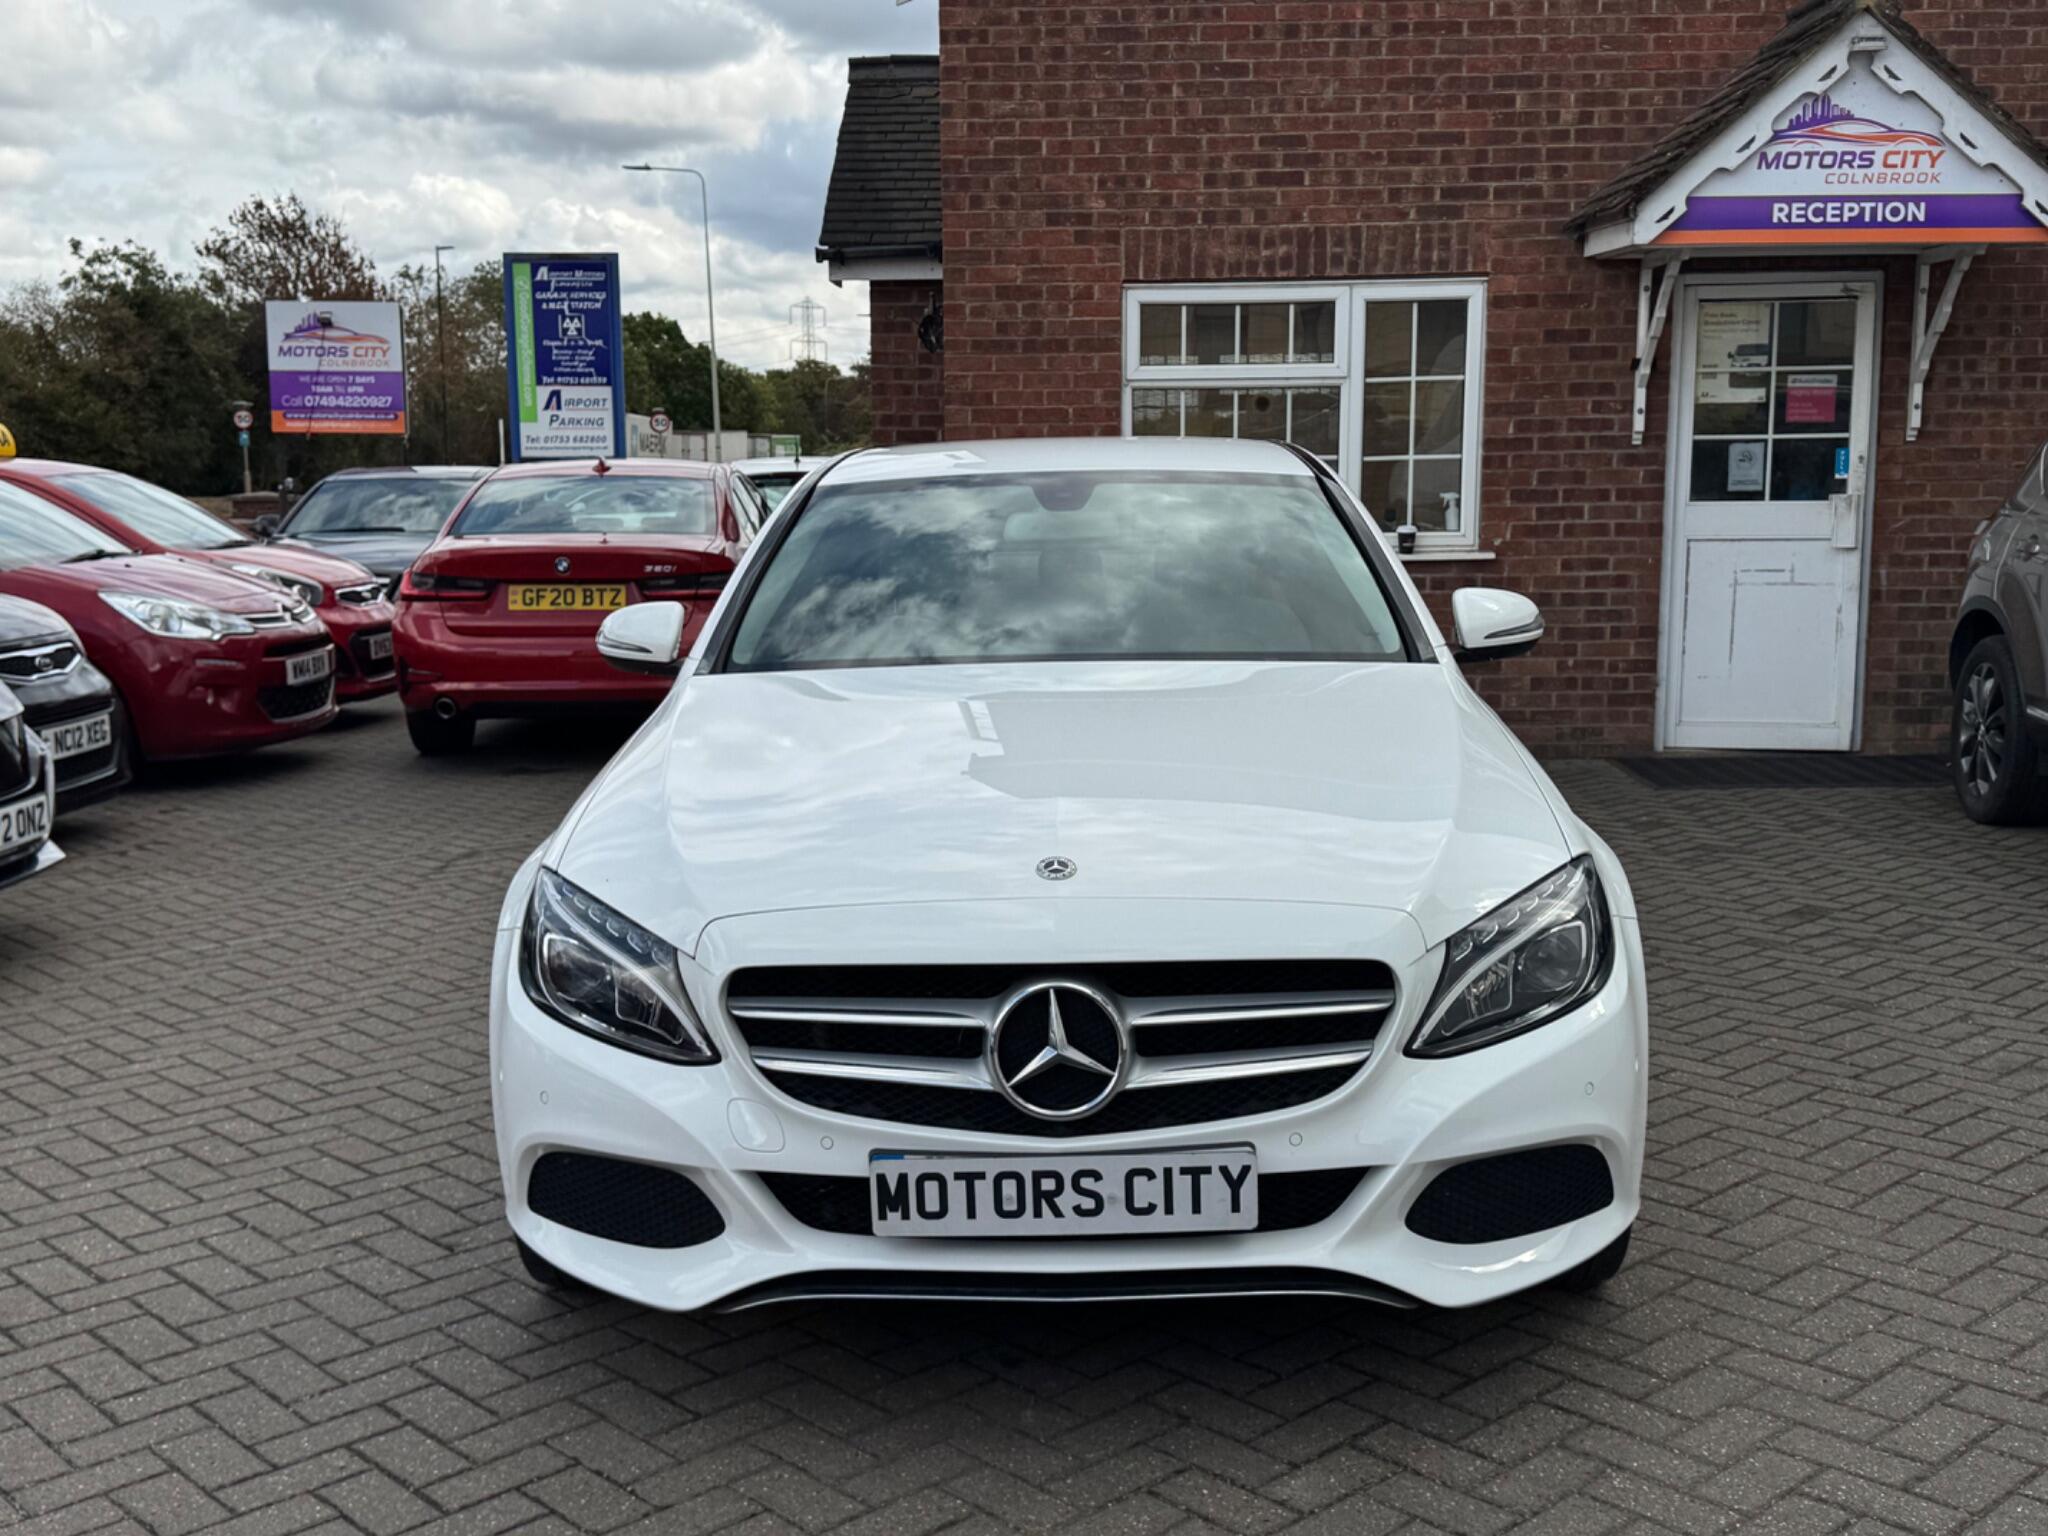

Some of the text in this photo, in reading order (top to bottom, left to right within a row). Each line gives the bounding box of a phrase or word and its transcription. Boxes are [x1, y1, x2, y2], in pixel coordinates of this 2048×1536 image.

[1757, 149, 1945, 170] MOTORS CITY
[1824, 172, 1942, 185] COLNBROOK
[1772, 201, 1926, 223] RECEPTION
[277, 346, 390, 358] MOTORS CITY
[281, 395, 303, 406] Call
[543, 389, 608, 411] AIRPORT
[549, 414, 604, 427] PARKING
[522, 588, 622, 606] GF20 BTZ
[53, 725, 84, 753] NC12
[876, 1164, 1252, 1221] MOTORS CITY
